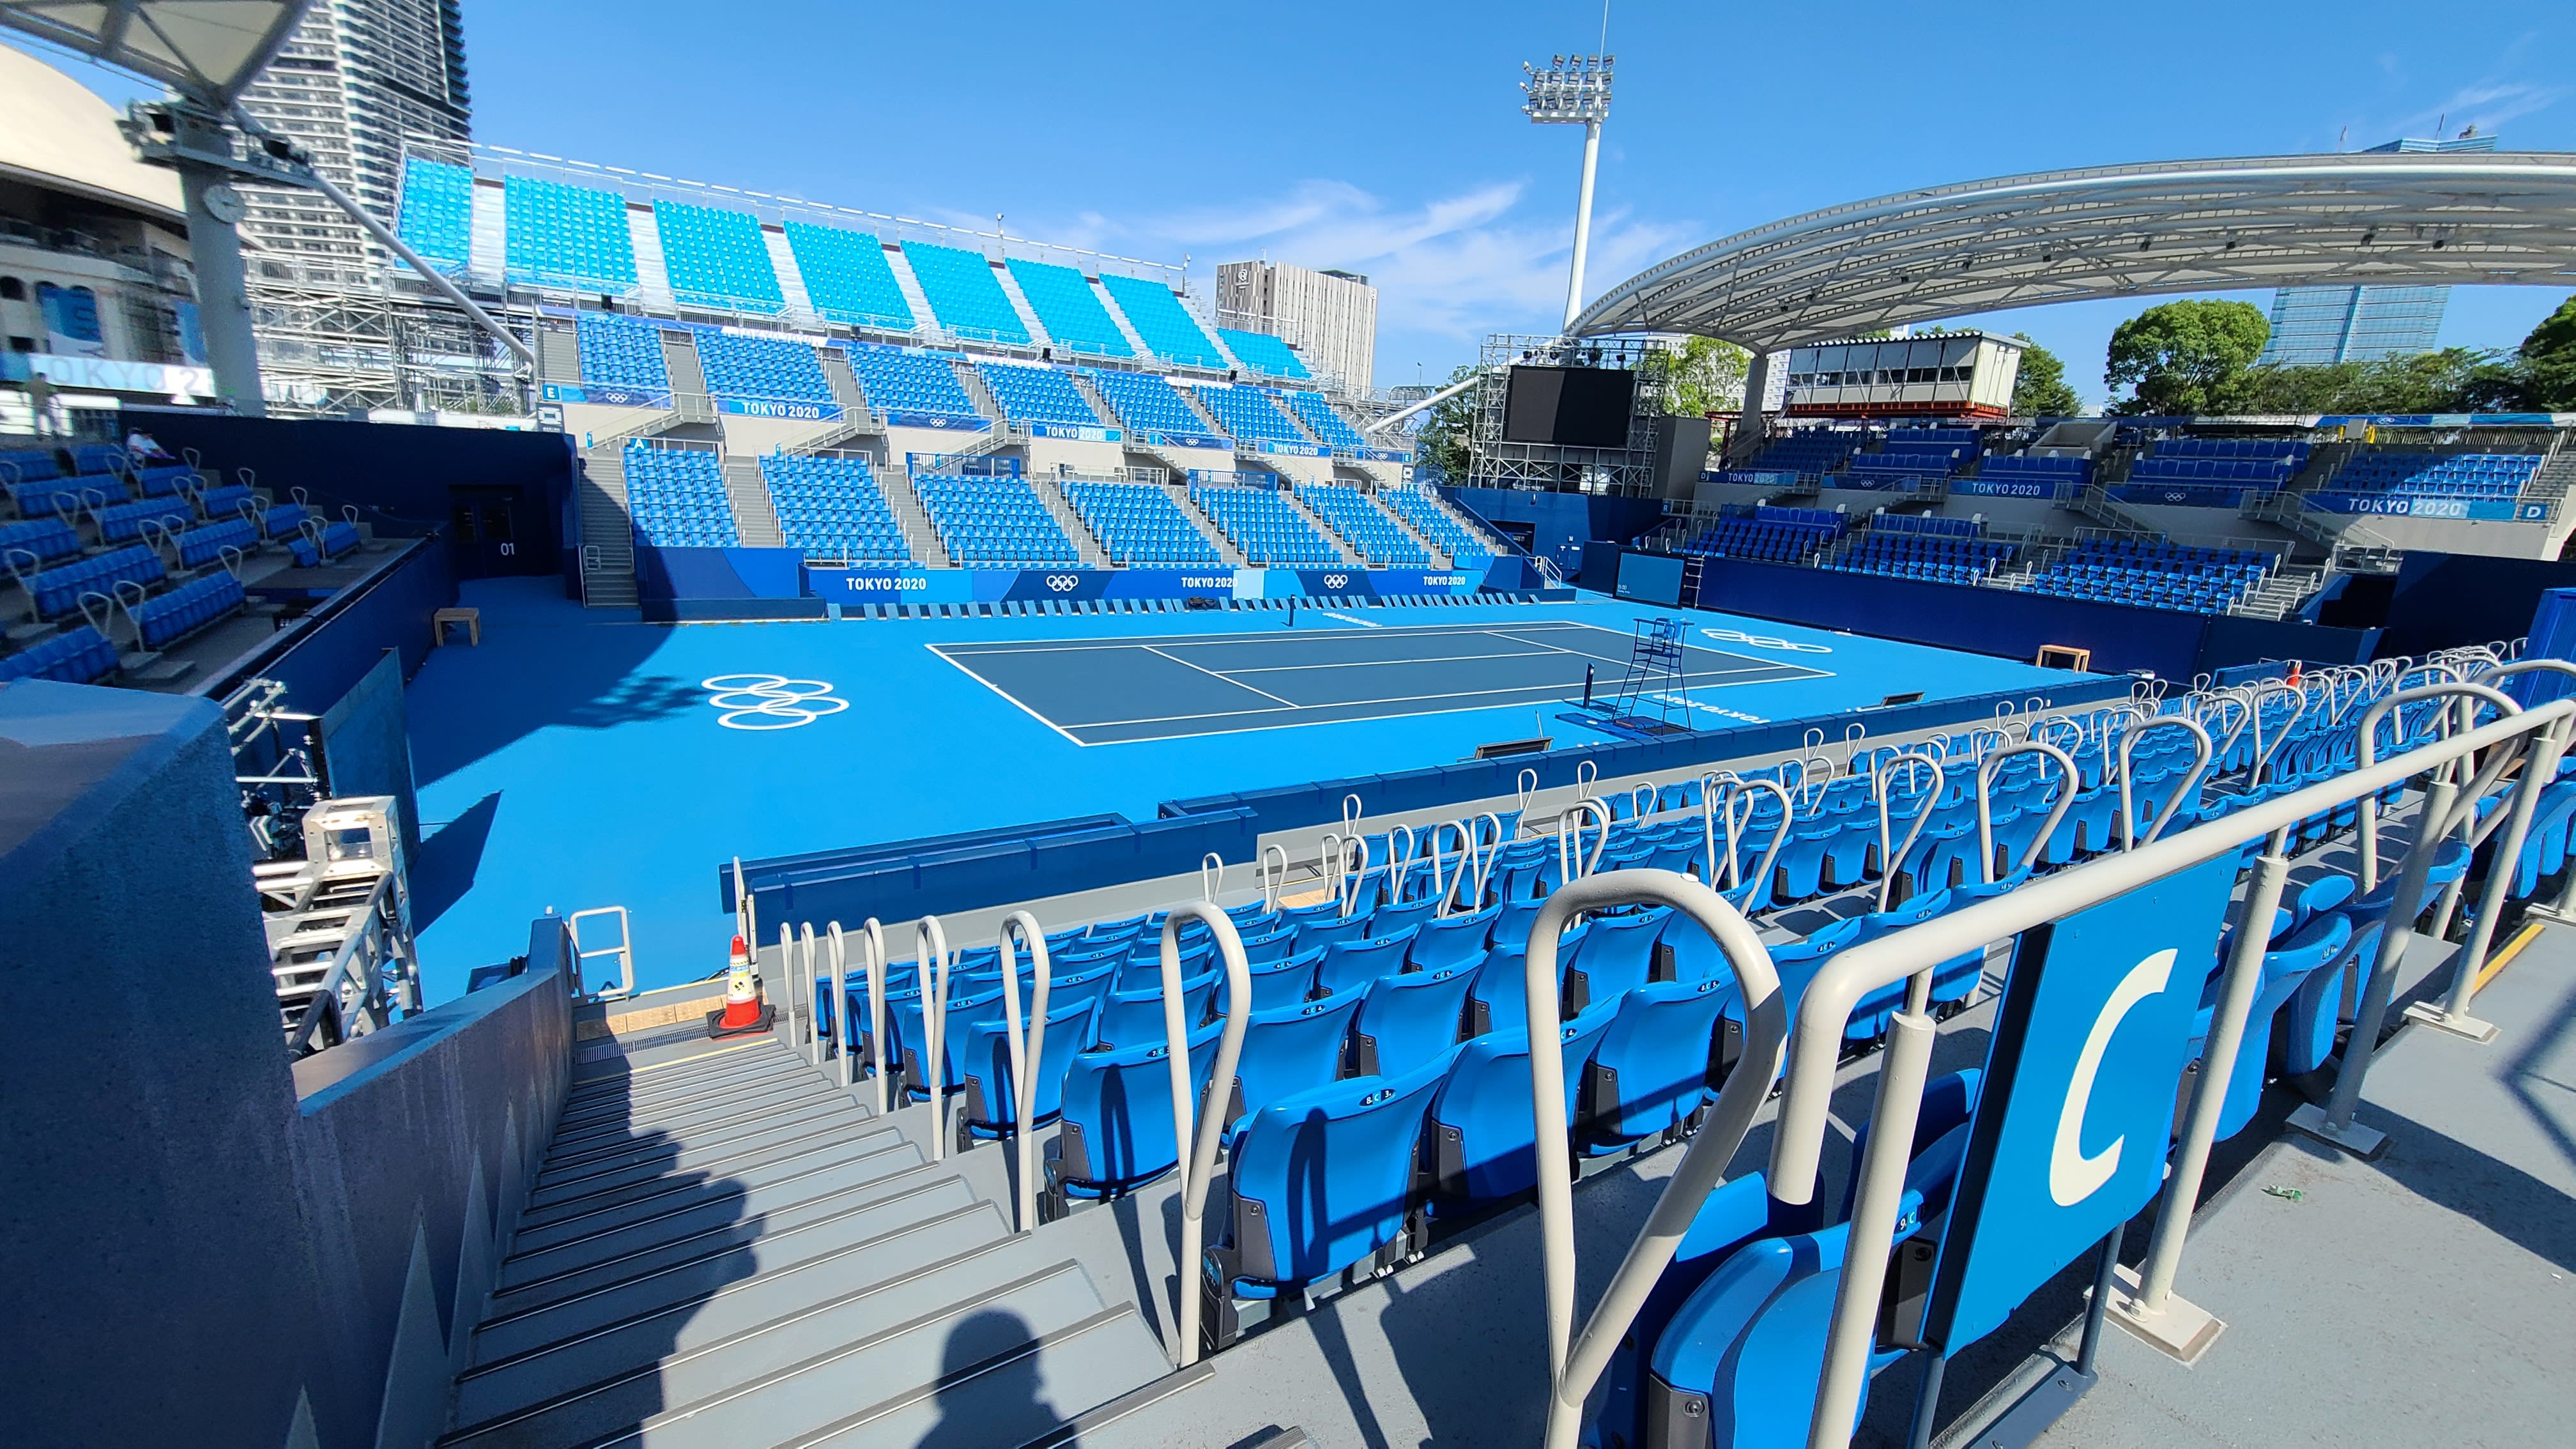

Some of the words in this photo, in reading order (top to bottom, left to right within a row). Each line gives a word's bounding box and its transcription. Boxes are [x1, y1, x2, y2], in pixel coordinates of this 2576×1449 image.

[547, 387, 555, 398] E
[742, 402, 786, 417] TOKYO
[788, 406, 820, 419] 2020
[1045, 426, 1078, 438] TOKYO
[1080, 429, 1103, 440] 2020
[634, 438, 644, 449] A
[1274, 443, 1299, 454] TOKYO
[1299, 446, 1319, 456] 2020
[1728, 473, 1754, 482] TOKYO
[1754, 475, 1775, 484] 2020
[1972, 483, 2009, 494] TOKYO
[2010, 485, 2041, 496] 2020
[2347, 498, 2409, 514] TOKYO
[2412, 500, 2462, 516] 2020
[2526, 506, 2542, 519] D
[500, 542, 515, 556] 01
[846, 577, 892, 591] TOKYO
[894, 577, 926, 590] 2020
[1181, 577, 1214, 588] TOKYO
[1215, 577, 1238, 588] 2020
[1423, 576, 1448, 586] TOKYO
[1447, 576, 1466, 586] 2020
[1699, 705, 1772, 724] TOKYO
[2050, 947, 2179, 1207] C
